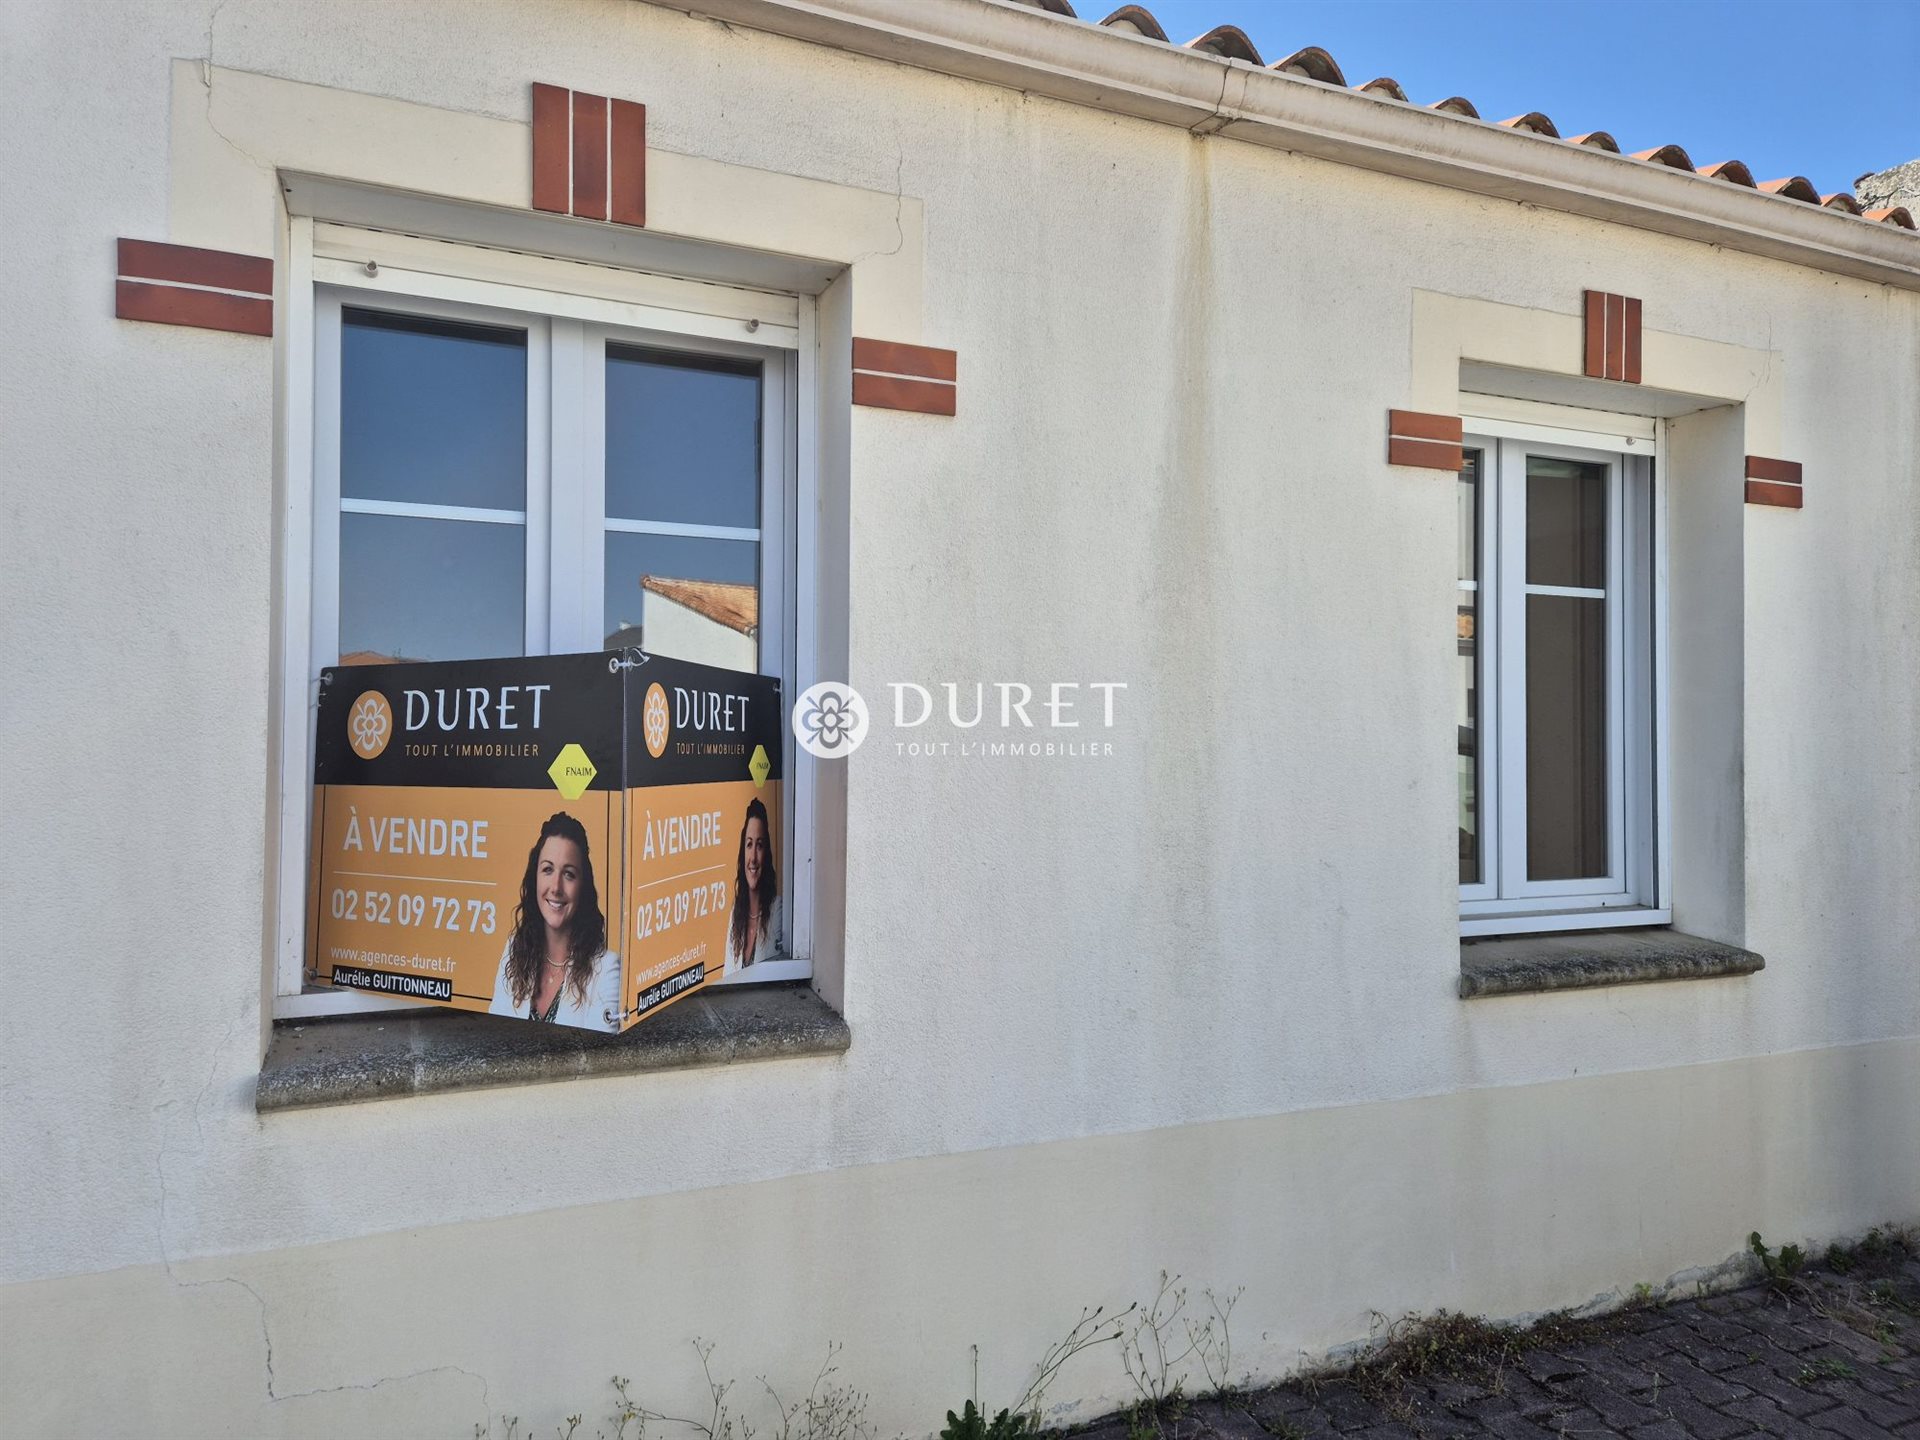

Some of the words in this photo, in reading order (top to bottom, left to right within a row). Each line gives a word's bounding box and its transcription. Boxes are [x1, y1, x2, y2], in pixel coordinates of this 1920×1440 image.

[403, 685, 551, 732] DURET
[674, 687, 750, 732] DURET
[405, 744, 438, 757] TOUT
[444, 743, 540, 757] L'IMMOBILIER
[565, 766, 592, 776] FNAIM
[676, 742, 694, 755] TOUT
[697, 742, 745, 755] L'IMMOBILIER
[343, 805, 363, 852] À
[369, 816, 489, 858] VENDRE
[642, 809, 655, 861] À
[657, 810, 722, 857] VENDRE
[331, 888, 359, 921] 02
[364, 890, 392, 924] 52
[397, 893, 426, 927] 09
[432, 895, 461, 932] 72
[467, 899, 497, 934] 73
[637, 902, 653, 940] 02
[655, 896, 671, 933] 52
[674, 890, 689, 925] 09
[692, 885, 708, 919] 72
[710, 881, 726, 913] 73
[330, 946, 457, 973] www.agences-duret.fr
[333, 968, 371, 987] Aurélie
[373, 973, 450, 998] GUITTONNEAU
[637, 987, 661, 1013] Aurélie
[660, 965, 704, 999] GUITTONNEAU
